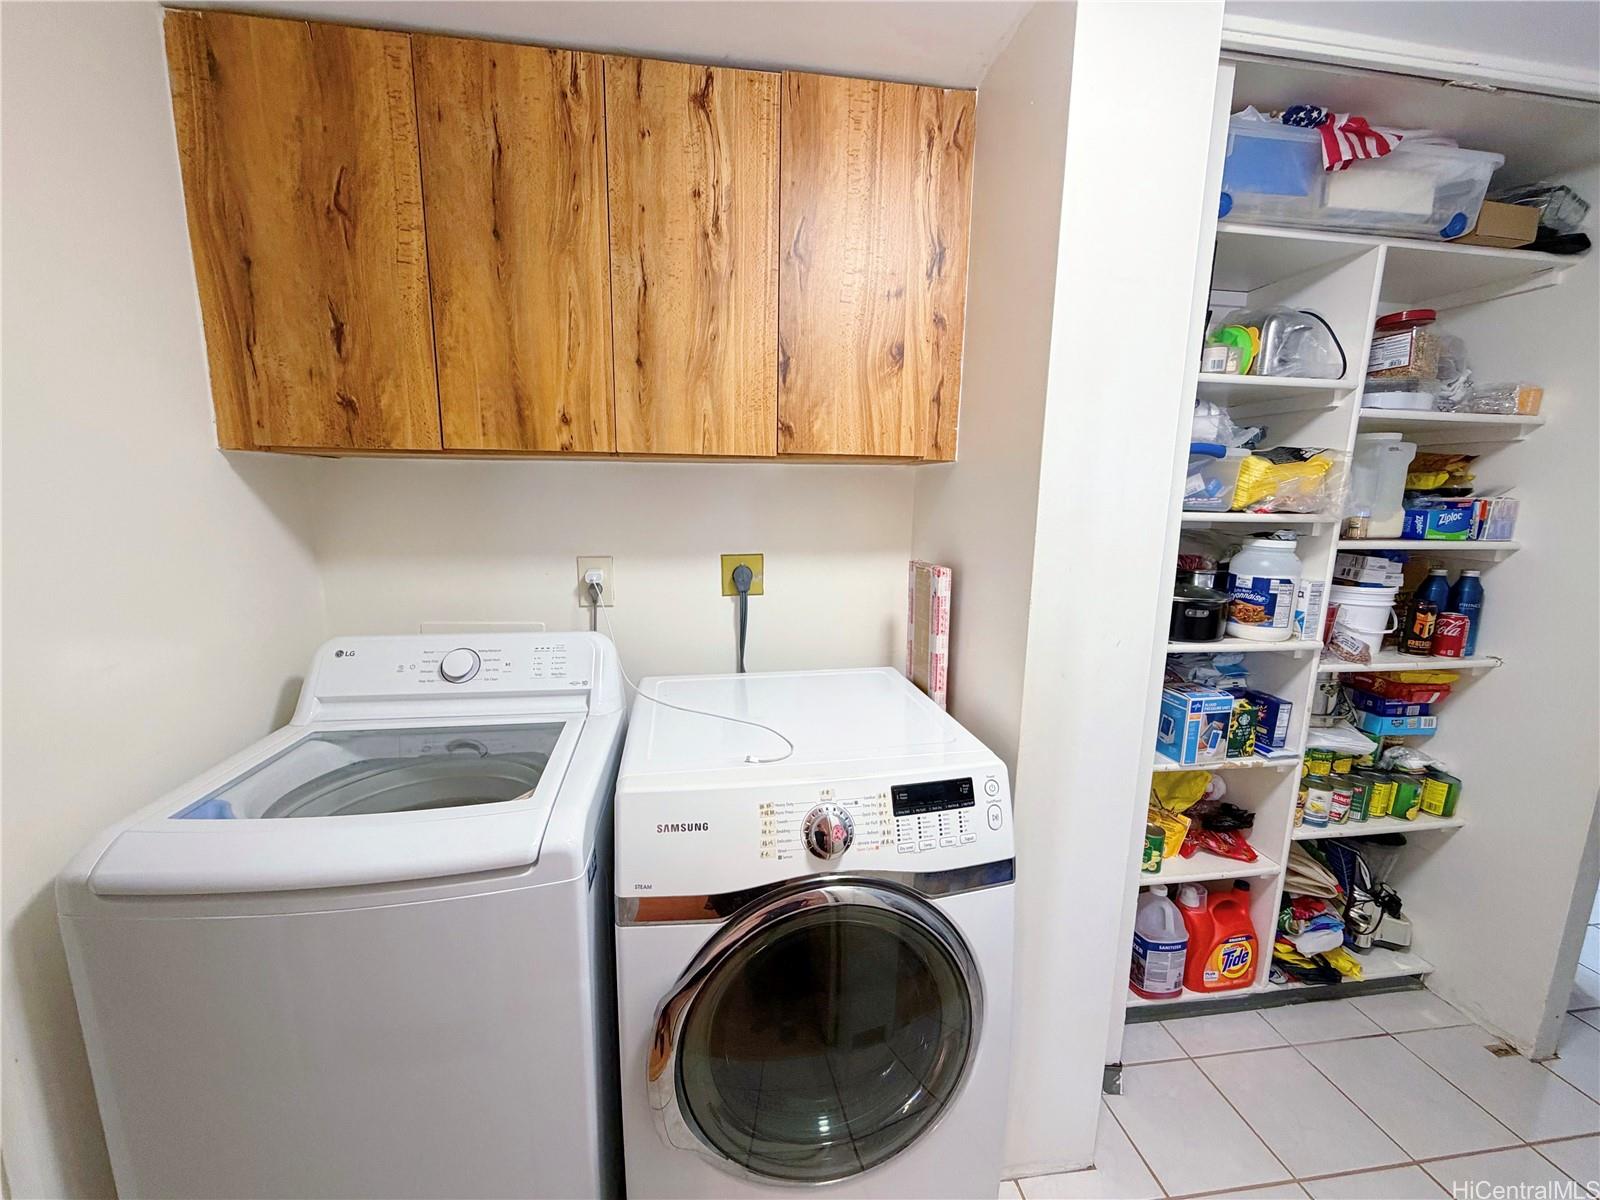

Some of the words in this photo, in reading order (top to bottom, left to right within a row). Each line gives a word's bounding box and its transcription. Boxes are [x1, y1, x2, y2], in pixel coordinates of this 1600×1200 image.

[1415, 515, 1424, 535] Ziploc
[1438, 512, 1463, 525] Ziploc
[1230, 591, 1267, 603] yonnaise
[656, 822, 709, 833] SAMSUNG
[1222, 948, 1250, 973] Tide
